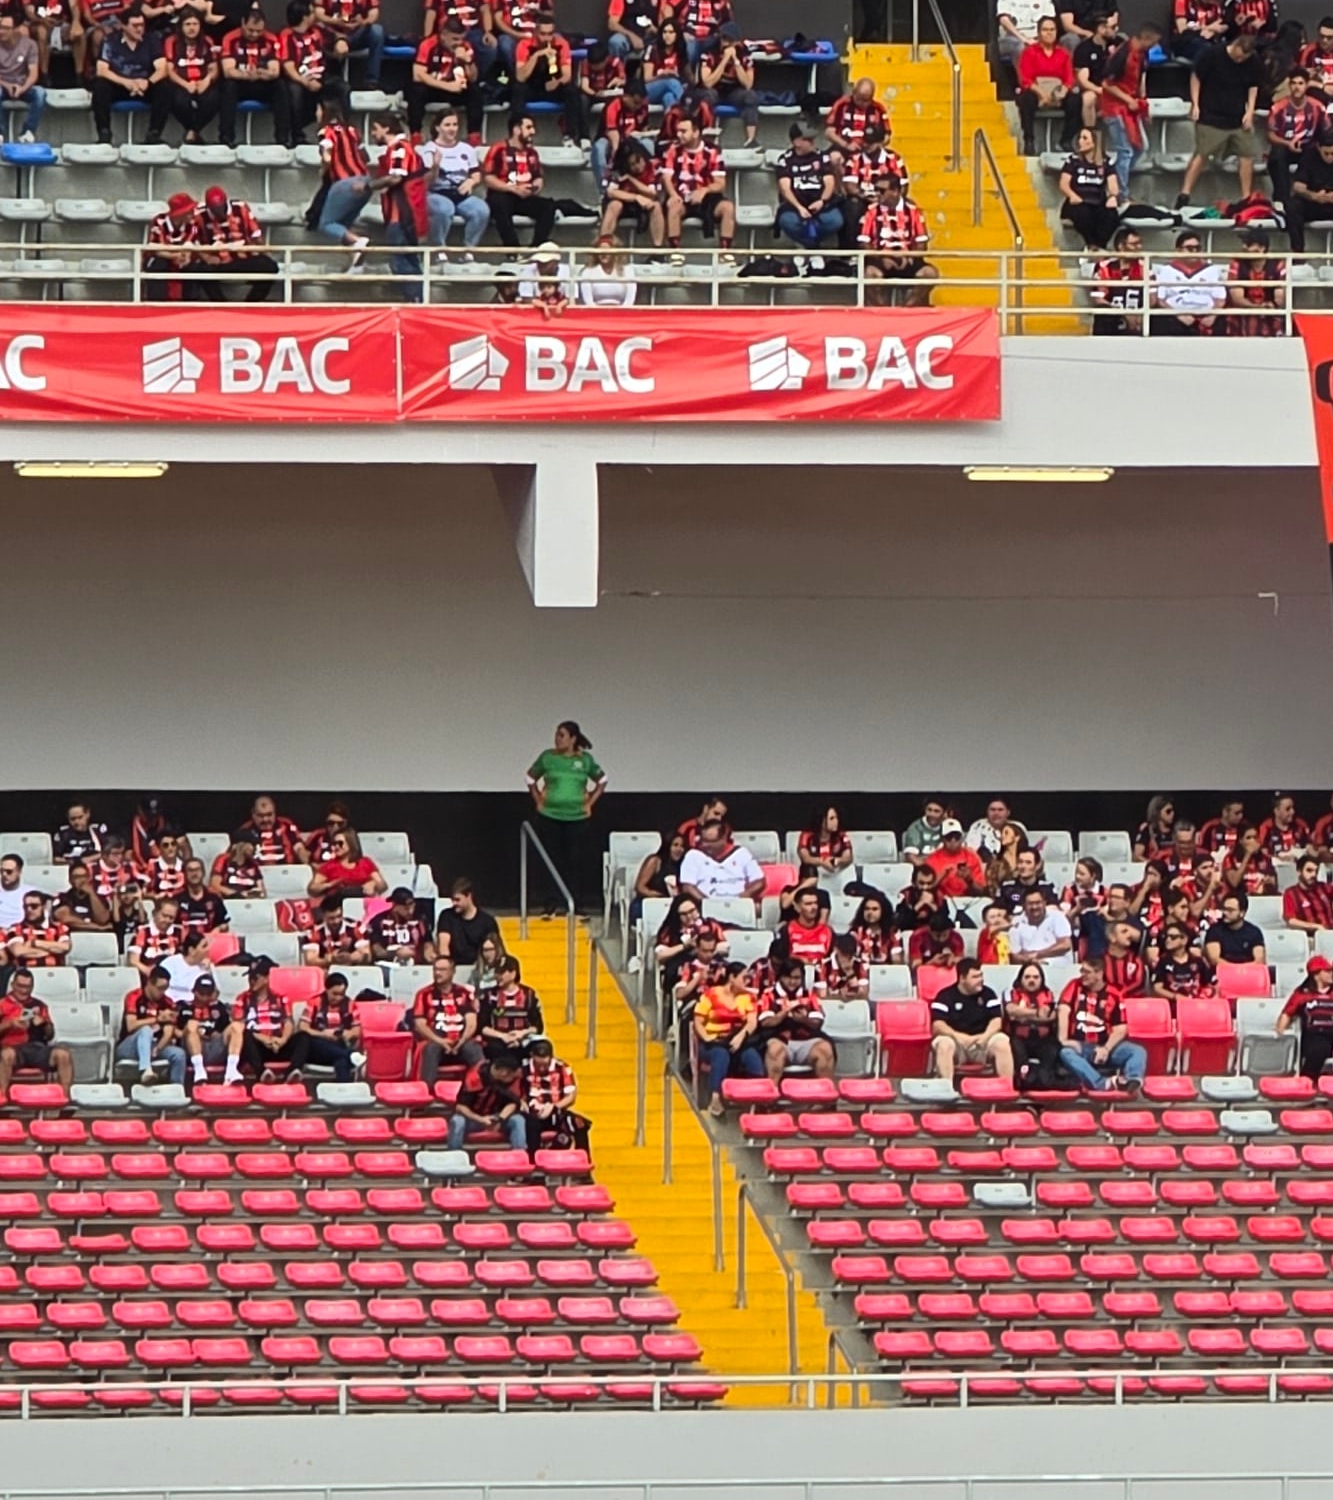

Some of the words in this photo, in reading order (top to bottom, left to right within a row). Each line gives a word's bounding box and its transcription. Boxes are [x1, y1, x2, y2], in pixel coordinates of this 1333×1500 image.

[219, 337, 351, 395] BAC
[525, 336, 656, 394] BAC
[826, 334, 955, 392] BAC
